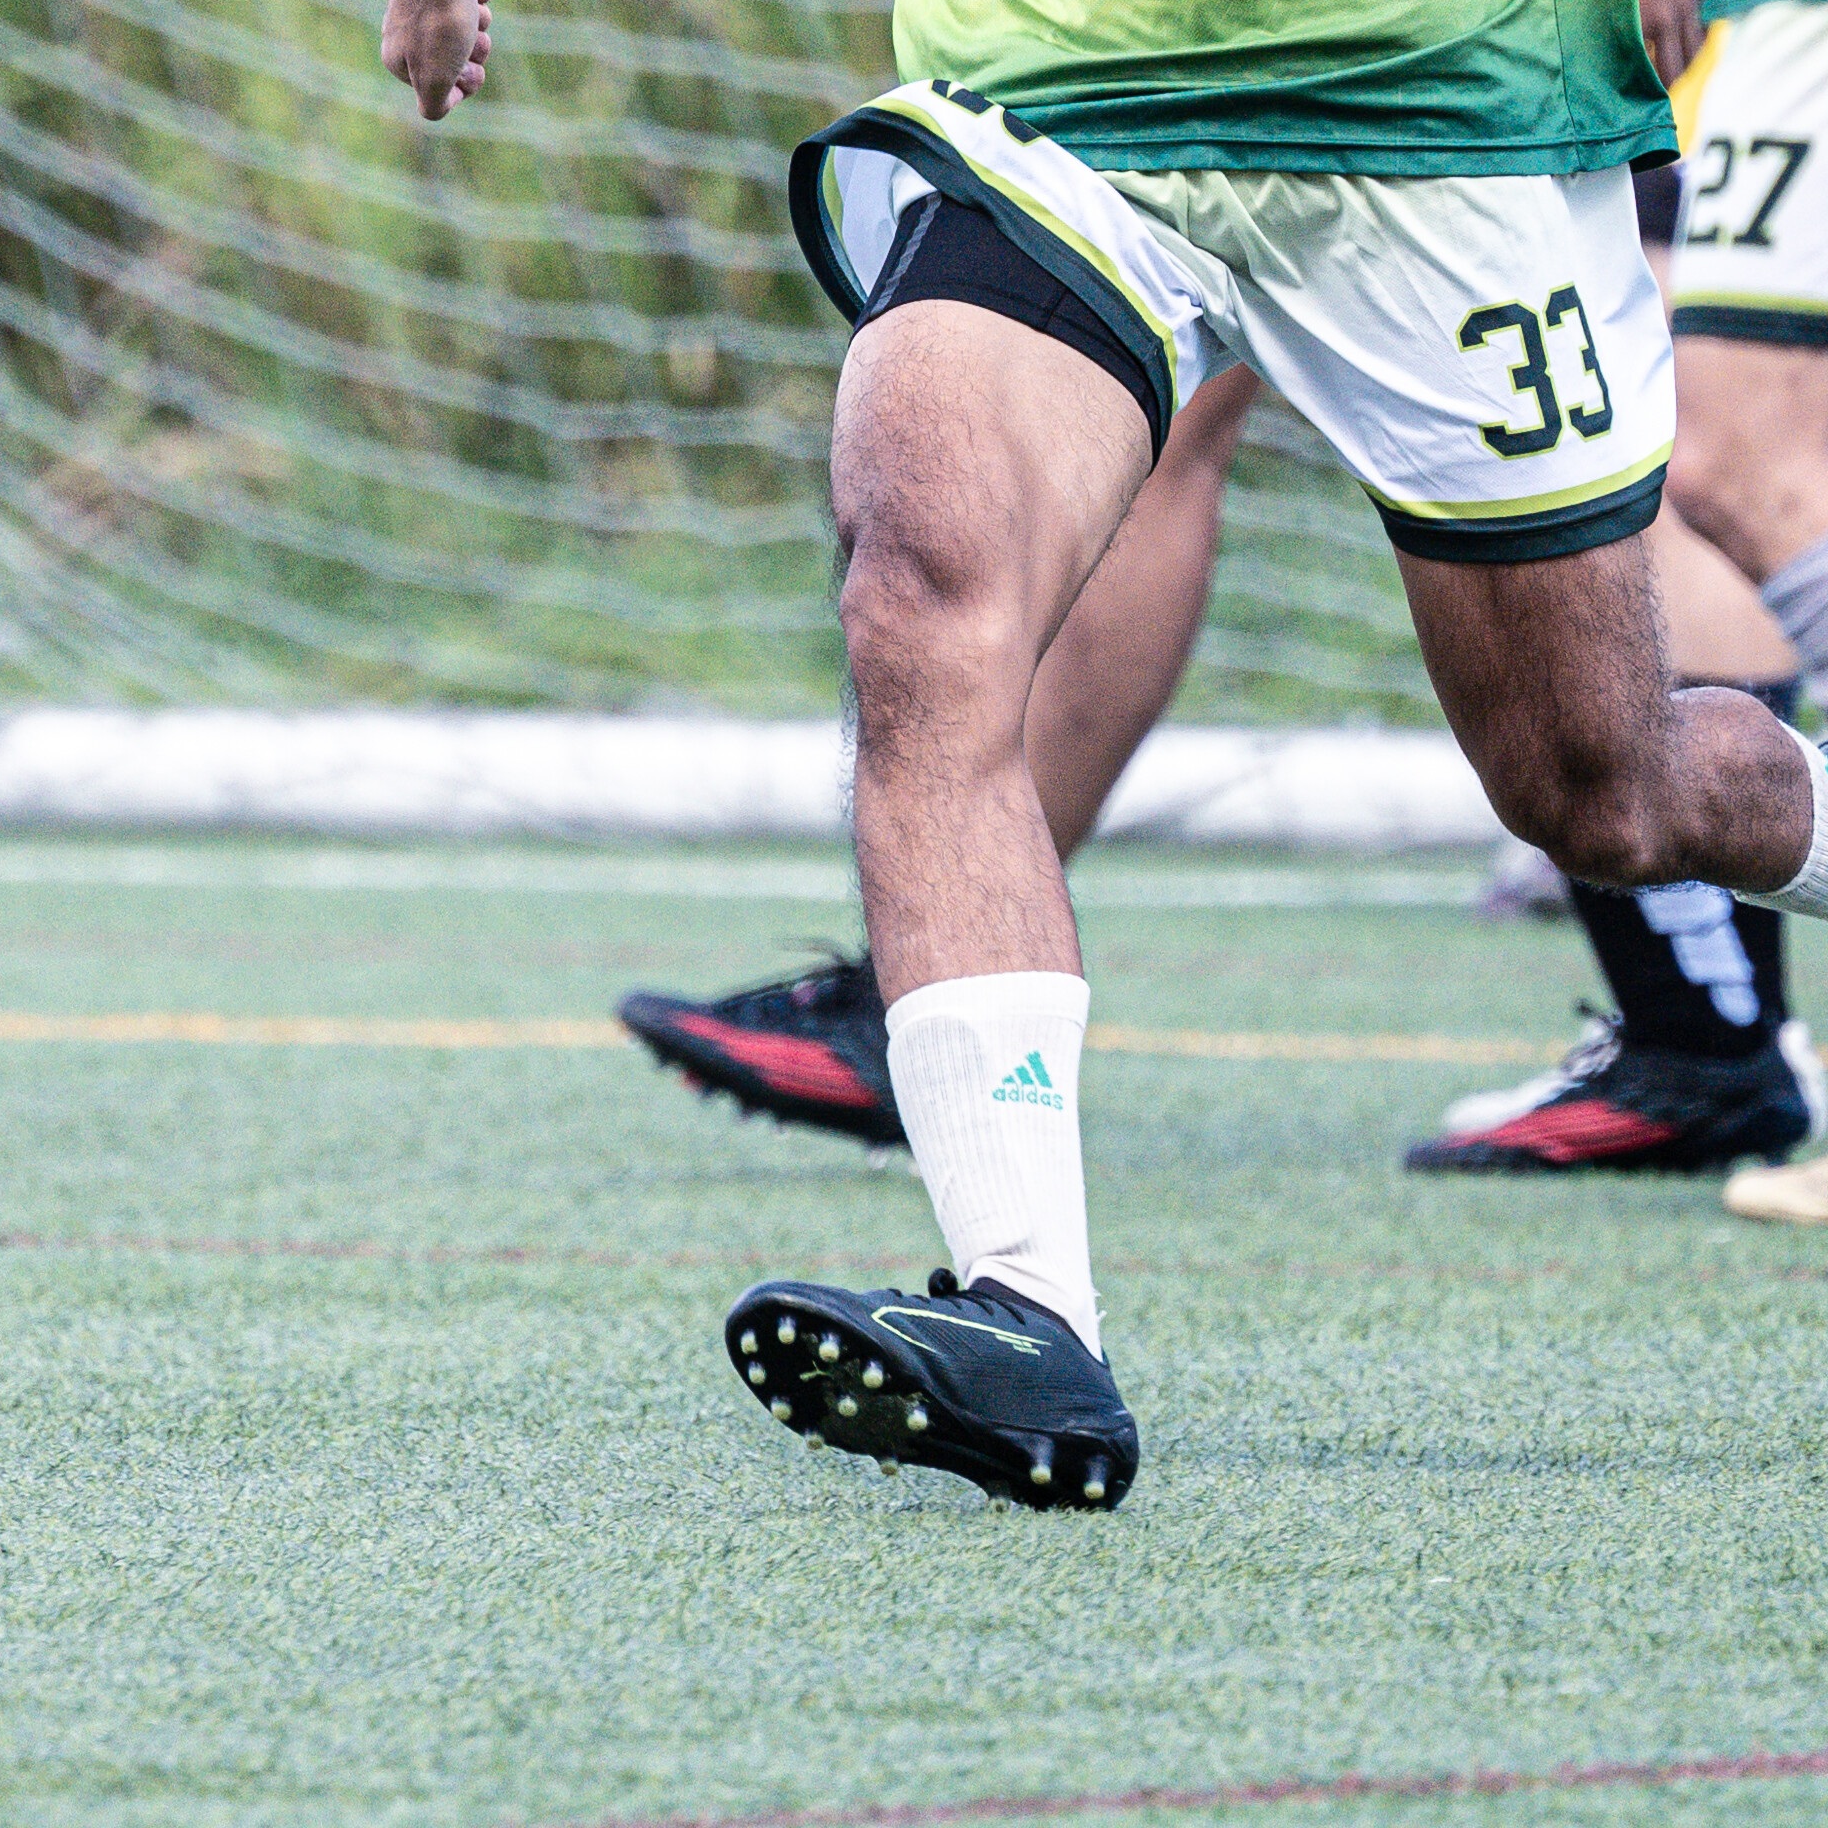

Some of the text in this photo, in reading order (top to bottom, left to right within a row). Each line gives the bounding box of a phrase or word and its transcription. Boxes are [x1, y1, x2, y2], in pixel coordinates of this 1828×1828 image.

[1686, 136, 1813, 246] 27
[1455, 280, 1614, 462] 33
[992, 1081, 1064, 1111] adidas
